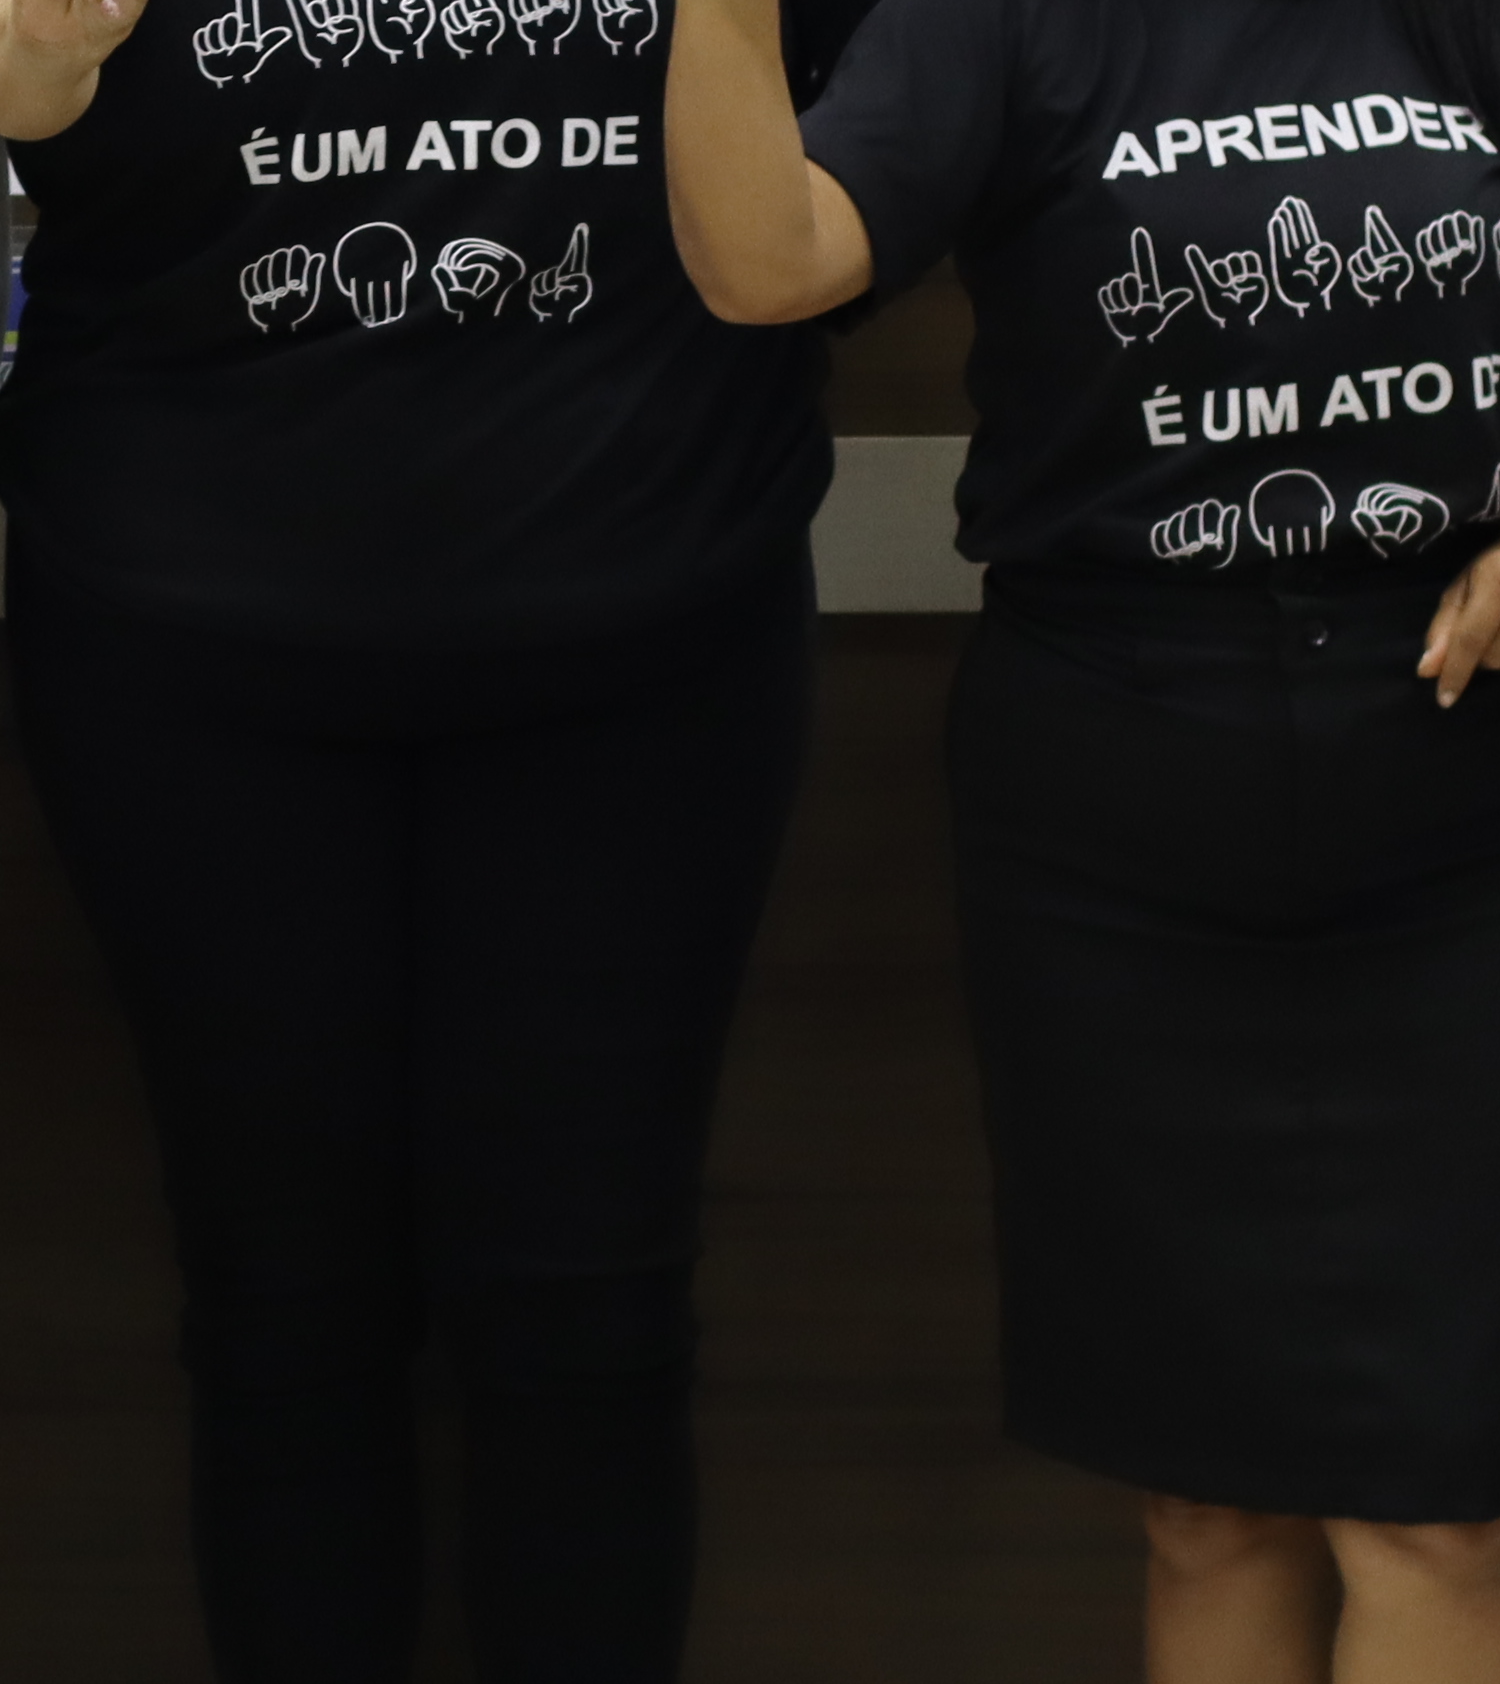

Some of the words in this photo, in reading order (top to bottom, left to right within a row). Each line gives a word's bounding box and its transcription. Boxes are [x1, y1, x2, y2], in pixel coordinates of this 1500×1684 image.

[240, 126, 281, 185] É
[291, 125, 388, 183] UM
[405, 117, 542, 171] ATO
[561, 115, 640, 168] DE
[1101, 93, 1499, 180] APRENDER
[1142, 384, 1187, 447] É
[1202, 382, 1300, 443] UM
[1319, 362, 1454, 428] ATO
